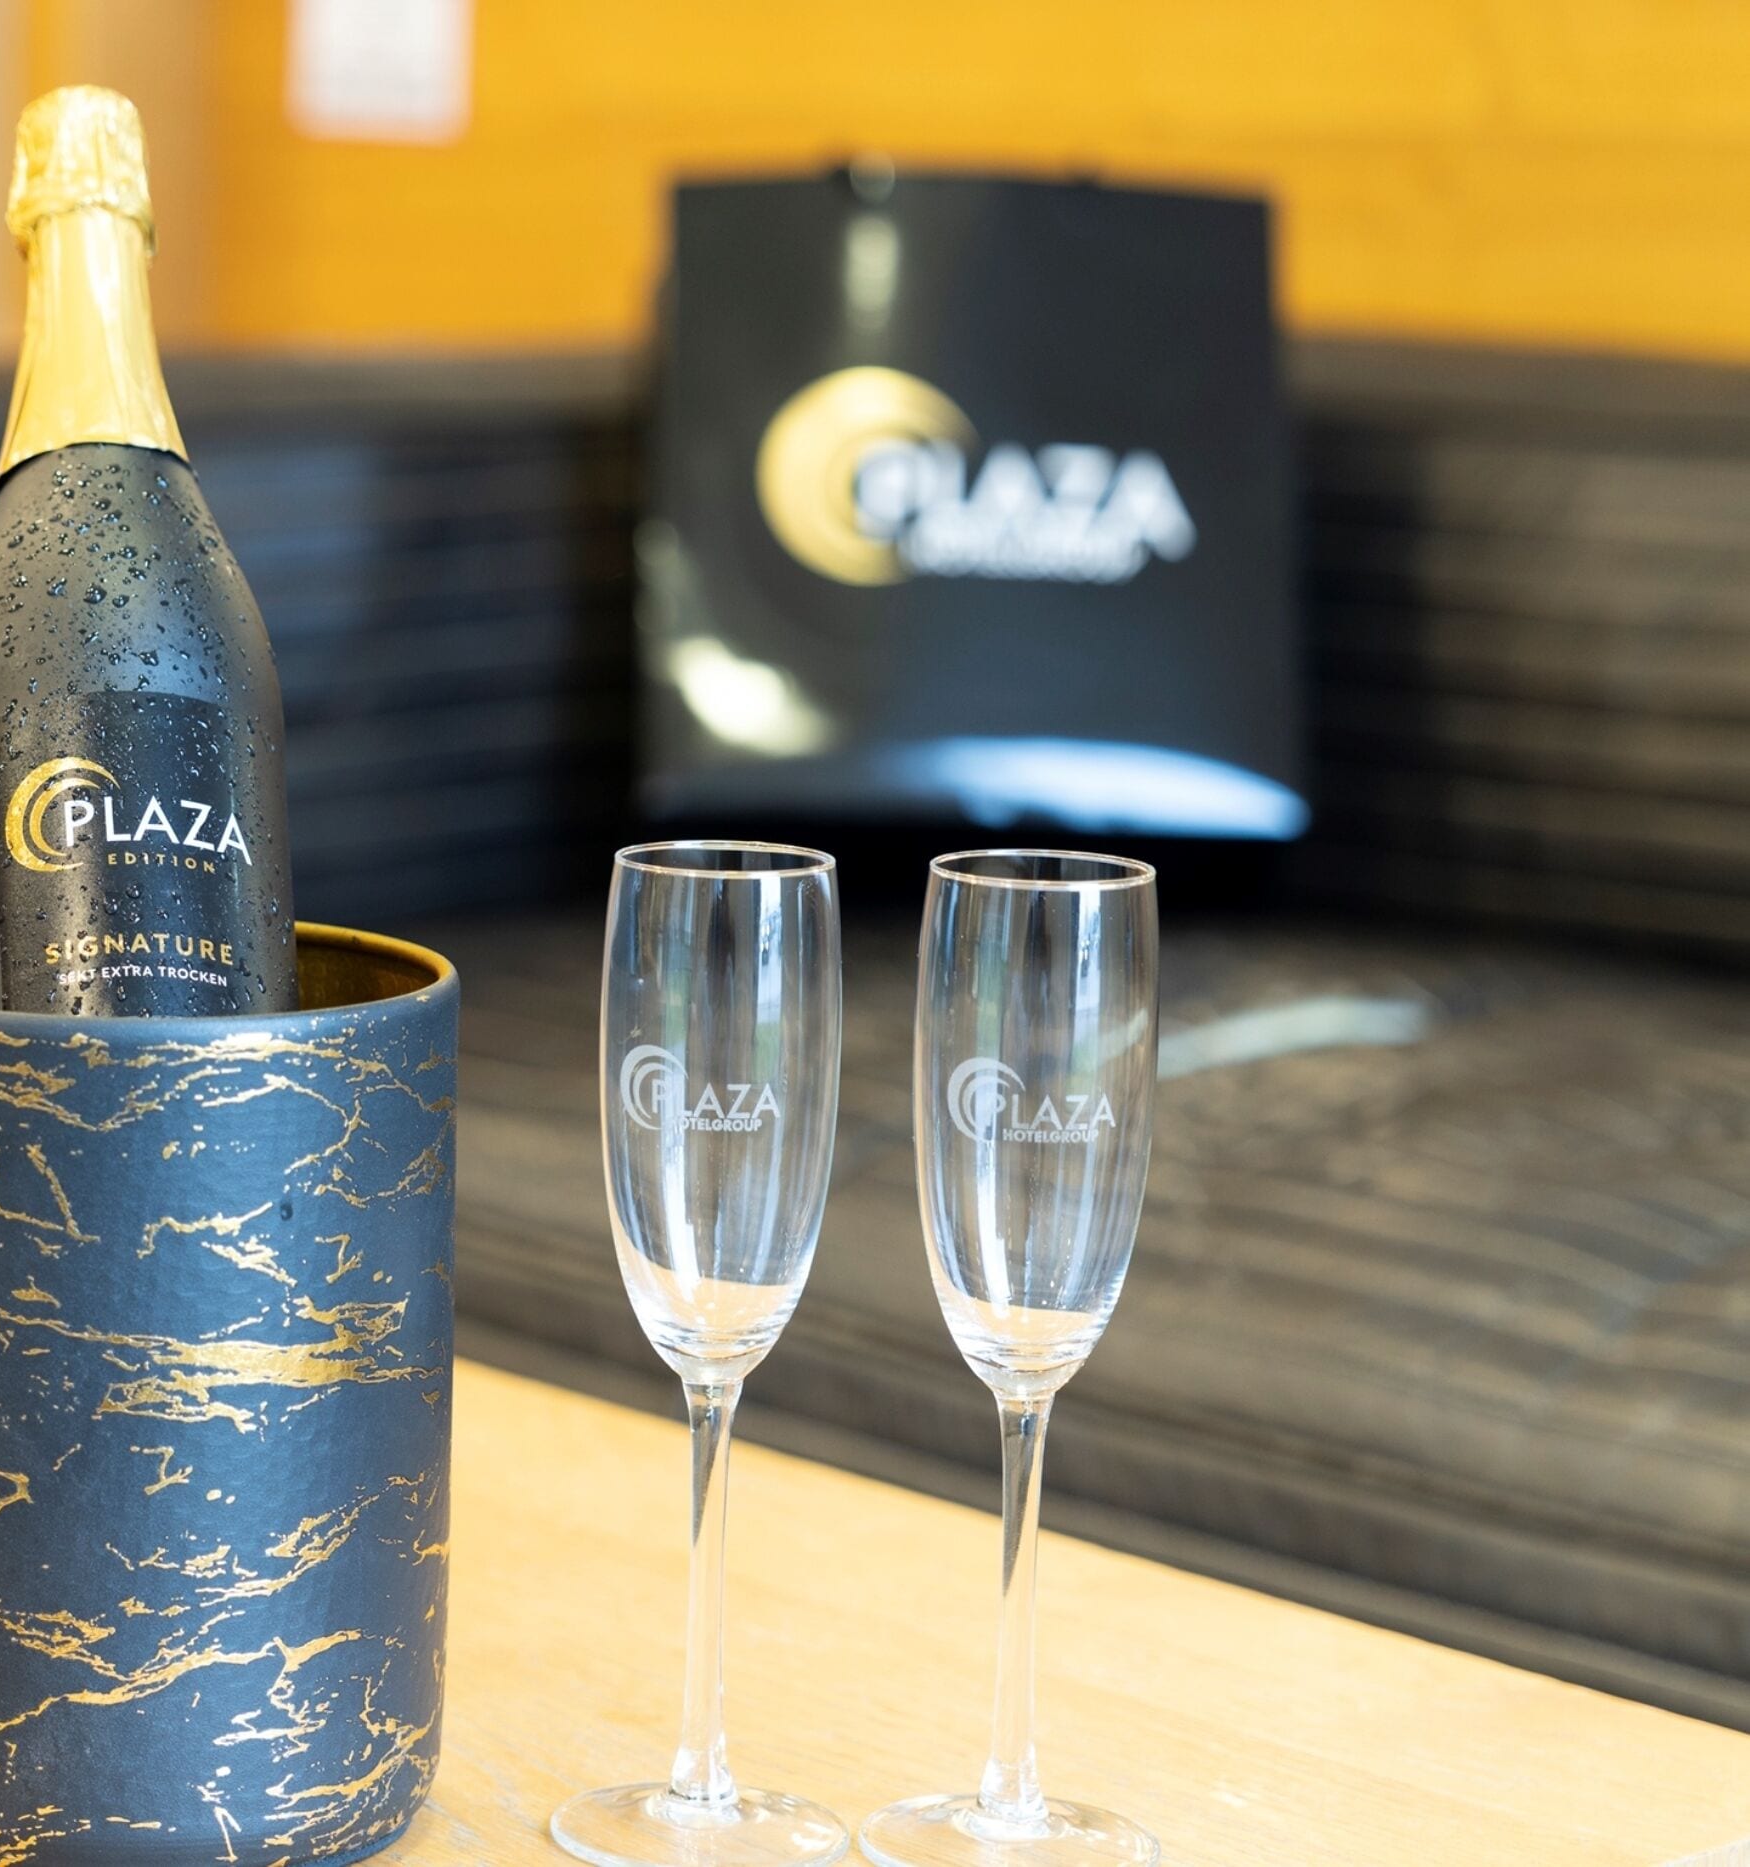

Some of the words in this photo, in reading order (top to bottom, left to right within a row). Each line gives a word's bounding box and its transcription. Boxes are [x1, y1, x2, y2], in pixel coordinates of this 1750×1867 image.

[64, 795, 252, 866] PLAZA
[107, 852, 215, 874] EDITION
[45, 933, 234, 966] SIGNATURE
[59, 968, 97, 985] SEKT
[101, 965, 153, 978] EXTRA
[157, 965, 227, 987] TROCKEN
[669, 1117, 763, 1132] OTELGROUP
[1002, 1128, 1099, 1144] HOTELGROUP
